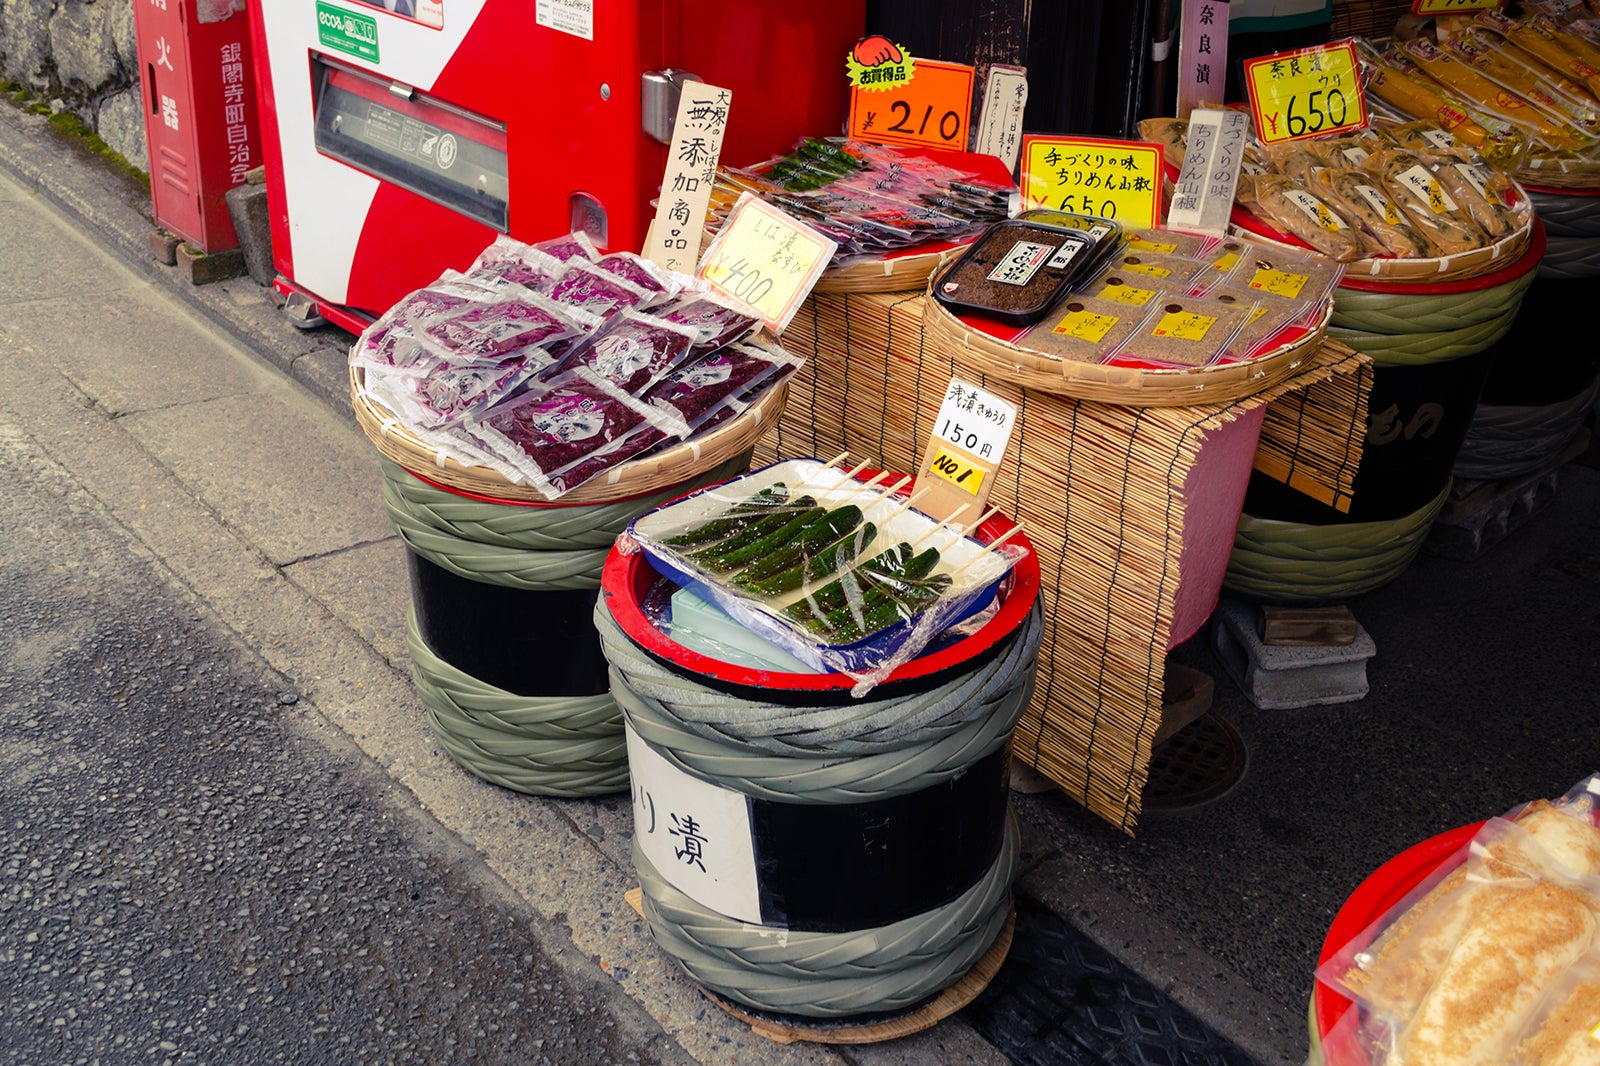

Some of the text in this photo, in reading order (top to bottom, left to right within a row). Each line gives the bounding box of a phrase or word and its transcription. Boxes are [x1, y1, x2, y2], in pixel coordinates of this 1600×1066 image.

[1196, 4, 1214, 85] 奈良漬
[859, 66, 906, 84] お買得品
[1270, 54, 1322, 79] 奈良漬
[1318, 73, 1341, 89] ウリ
[220, 43, 250, 183] 銀閣寺町自治会
[701, 91, 730, 186] 大原のしば漬
[1210, 114, 1244, 198] 手づくりの味
[1044, 147, 1140, 171] 手づくりの味
[1177, 124, 1211, 210] ちりめん山椒
[1056, 168, 1153, 191] ちりめん山椒
[753, 217, 797, 252] しば漬
[941, 419, 993, 458] 150円
[630, 771, 708, 873] り漬
